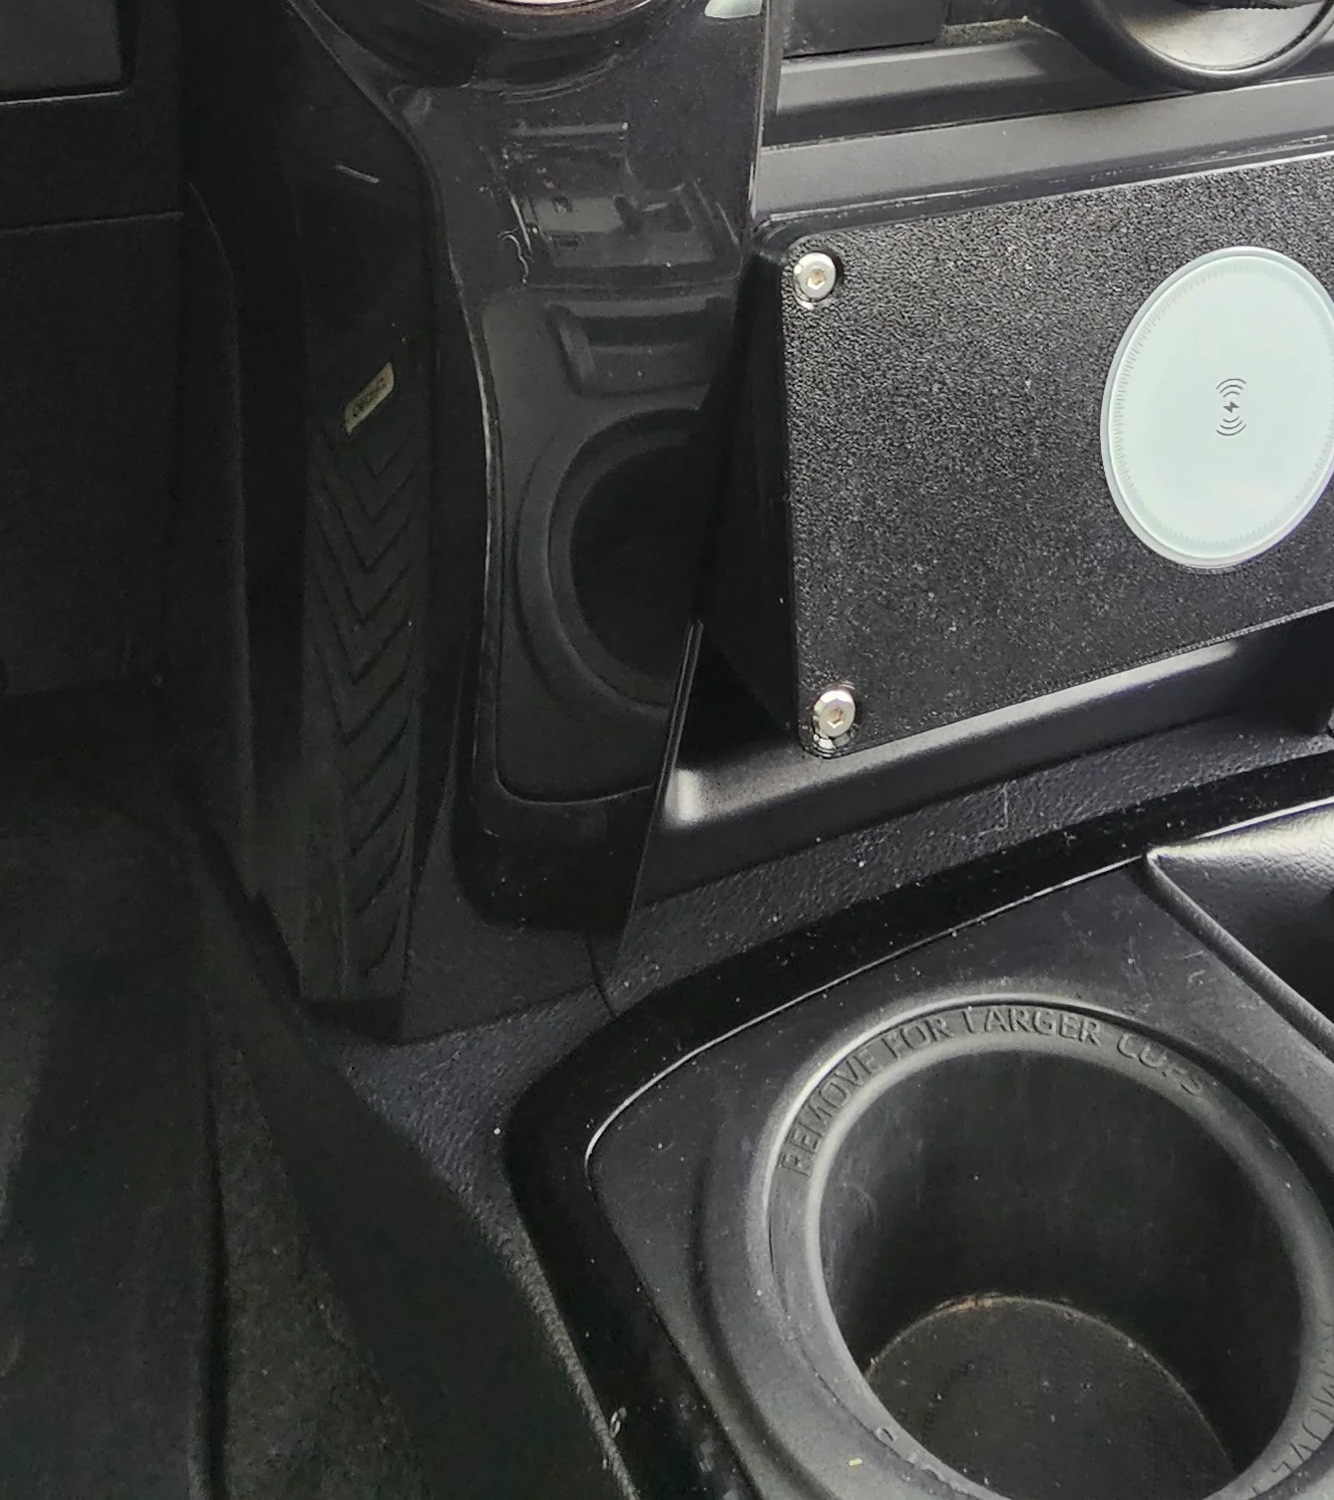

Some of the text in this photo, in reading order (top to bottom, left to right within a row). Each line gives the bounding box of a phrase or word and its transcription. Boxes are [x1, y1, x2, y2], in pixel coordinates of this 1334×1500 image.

[780, 1050, 875, 1177] REMOVE
[886, 1017, 956, 1062] FOR
[964, 1005, 1104, 1048] LARGER
